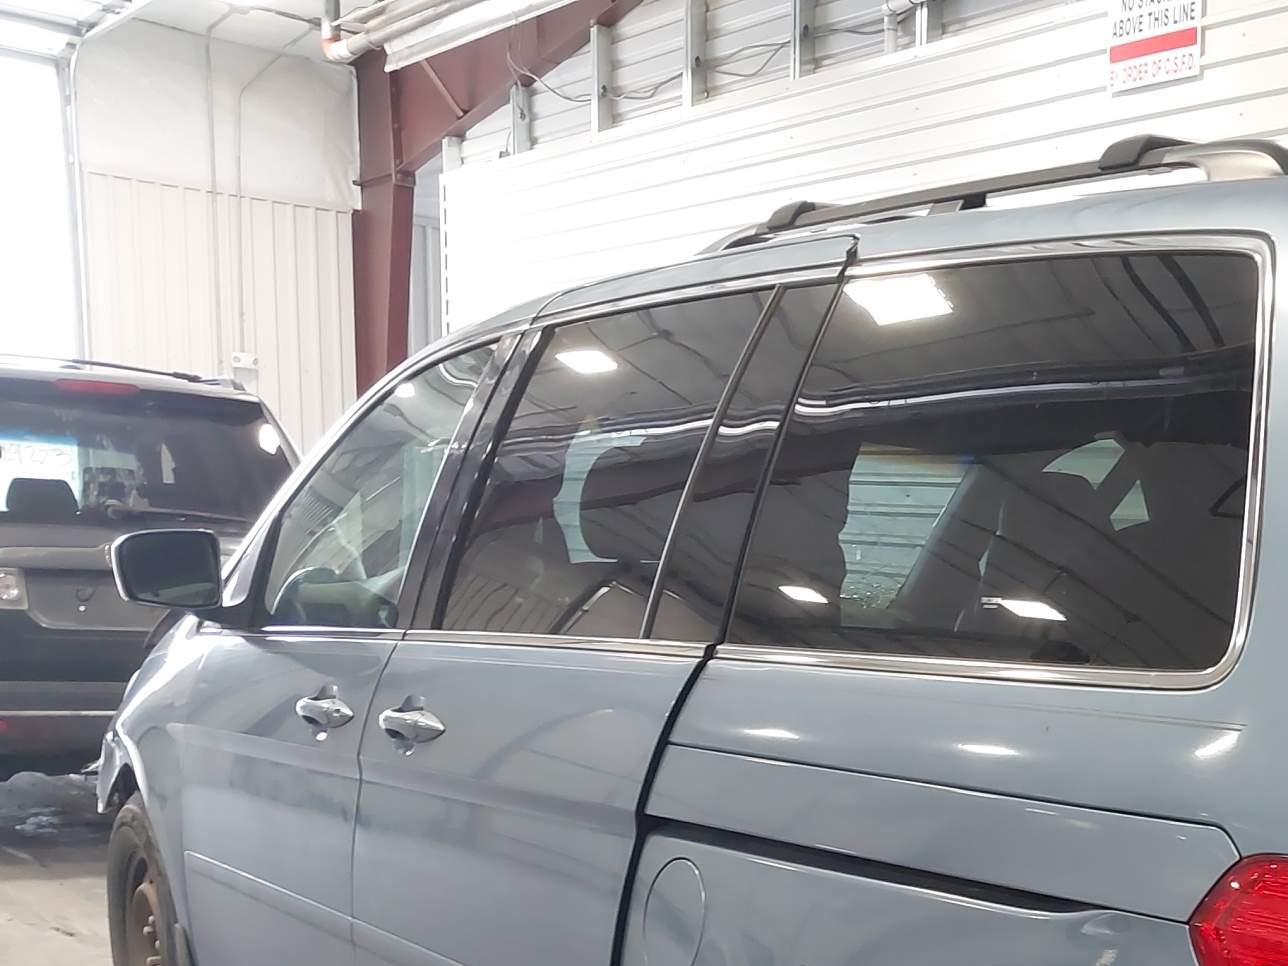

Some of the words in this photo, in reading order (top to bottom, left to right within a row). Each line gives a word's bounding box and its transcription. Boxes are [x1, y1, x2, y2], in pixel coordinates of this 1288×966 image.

[1121, 0, 1135, 12] NO
[1112, 13, 1144, 38] ABOVE
[1147, 7, 1170, 31] THIS
[1173, 1, 1197, 25] LINE
